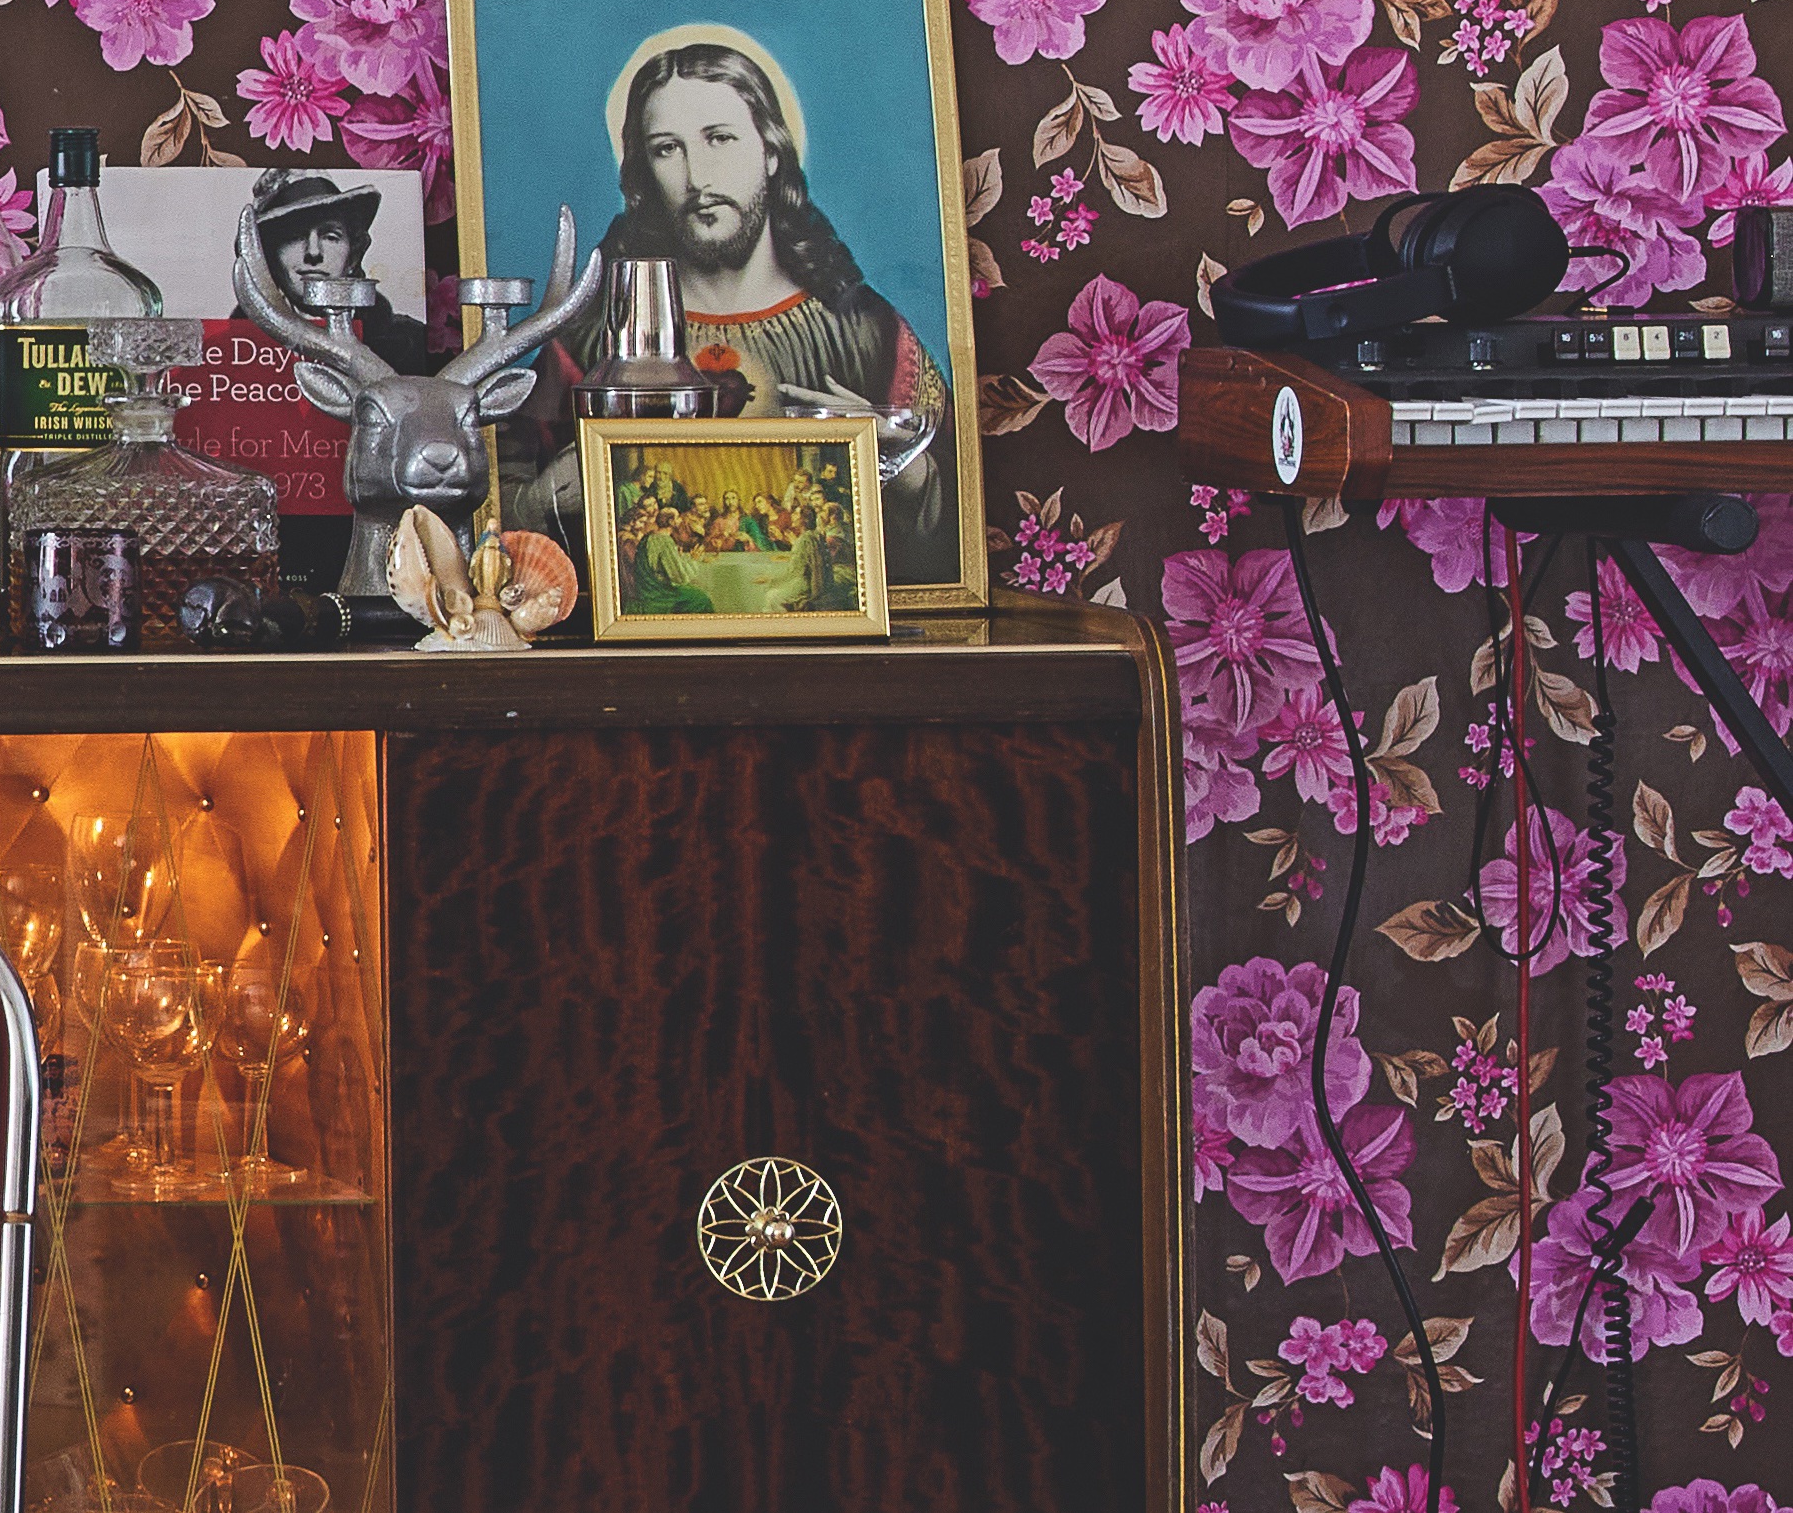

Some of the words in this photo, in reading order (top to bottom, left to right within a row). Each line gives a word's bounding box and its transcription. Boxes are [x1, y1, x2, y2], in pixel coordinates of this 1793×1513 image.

[18, 337, 95, 368] TULLA
[211, 374, 303, 403] Peaco
[34, 416, 69, 429] IRISH
